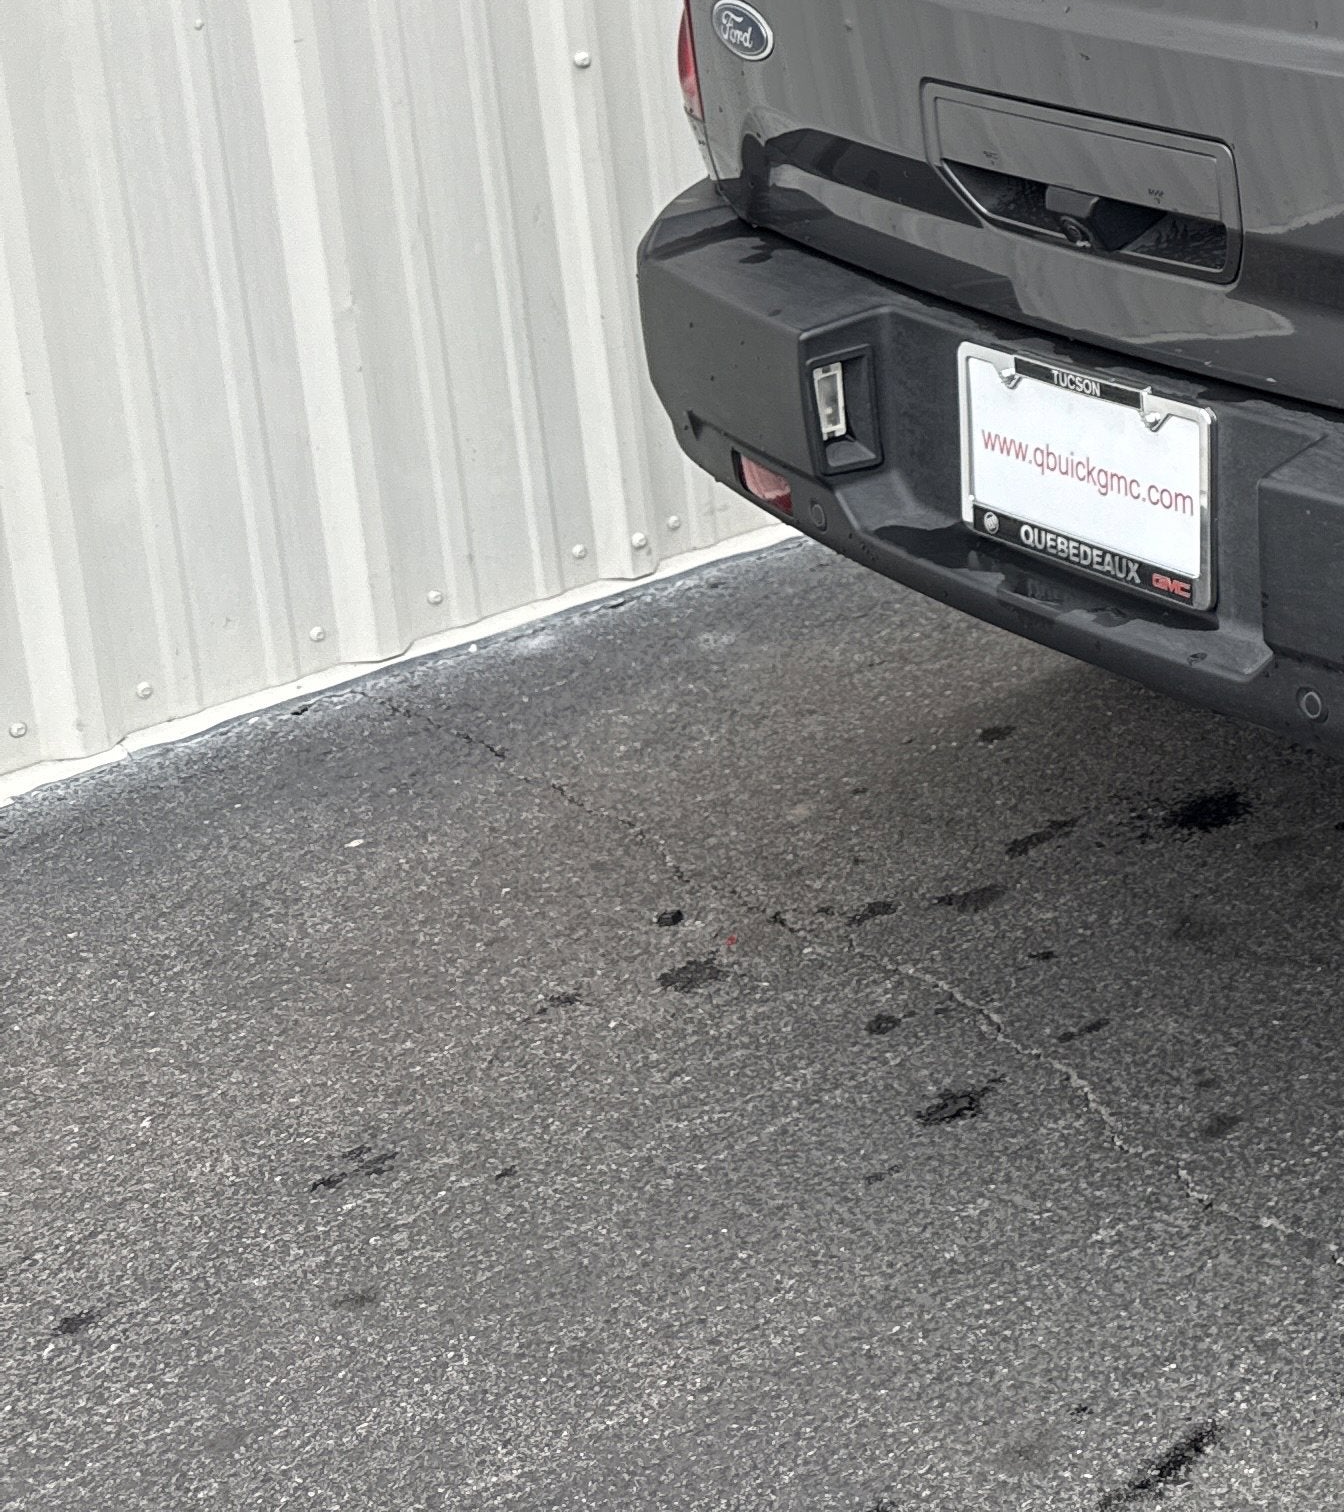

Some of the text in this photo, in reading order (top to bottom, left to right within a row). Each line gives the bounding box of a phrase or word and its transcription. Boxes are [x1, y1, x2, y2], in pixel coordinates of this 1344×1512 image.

[1052, 370, 1101, 397] TUCSON
[983, 430, 1194, 516] www.qbuickgmc.com
[1020, 525, 1141, 584] QUEBEDEAUX
[1152, 573, 1191, 598] GMC
